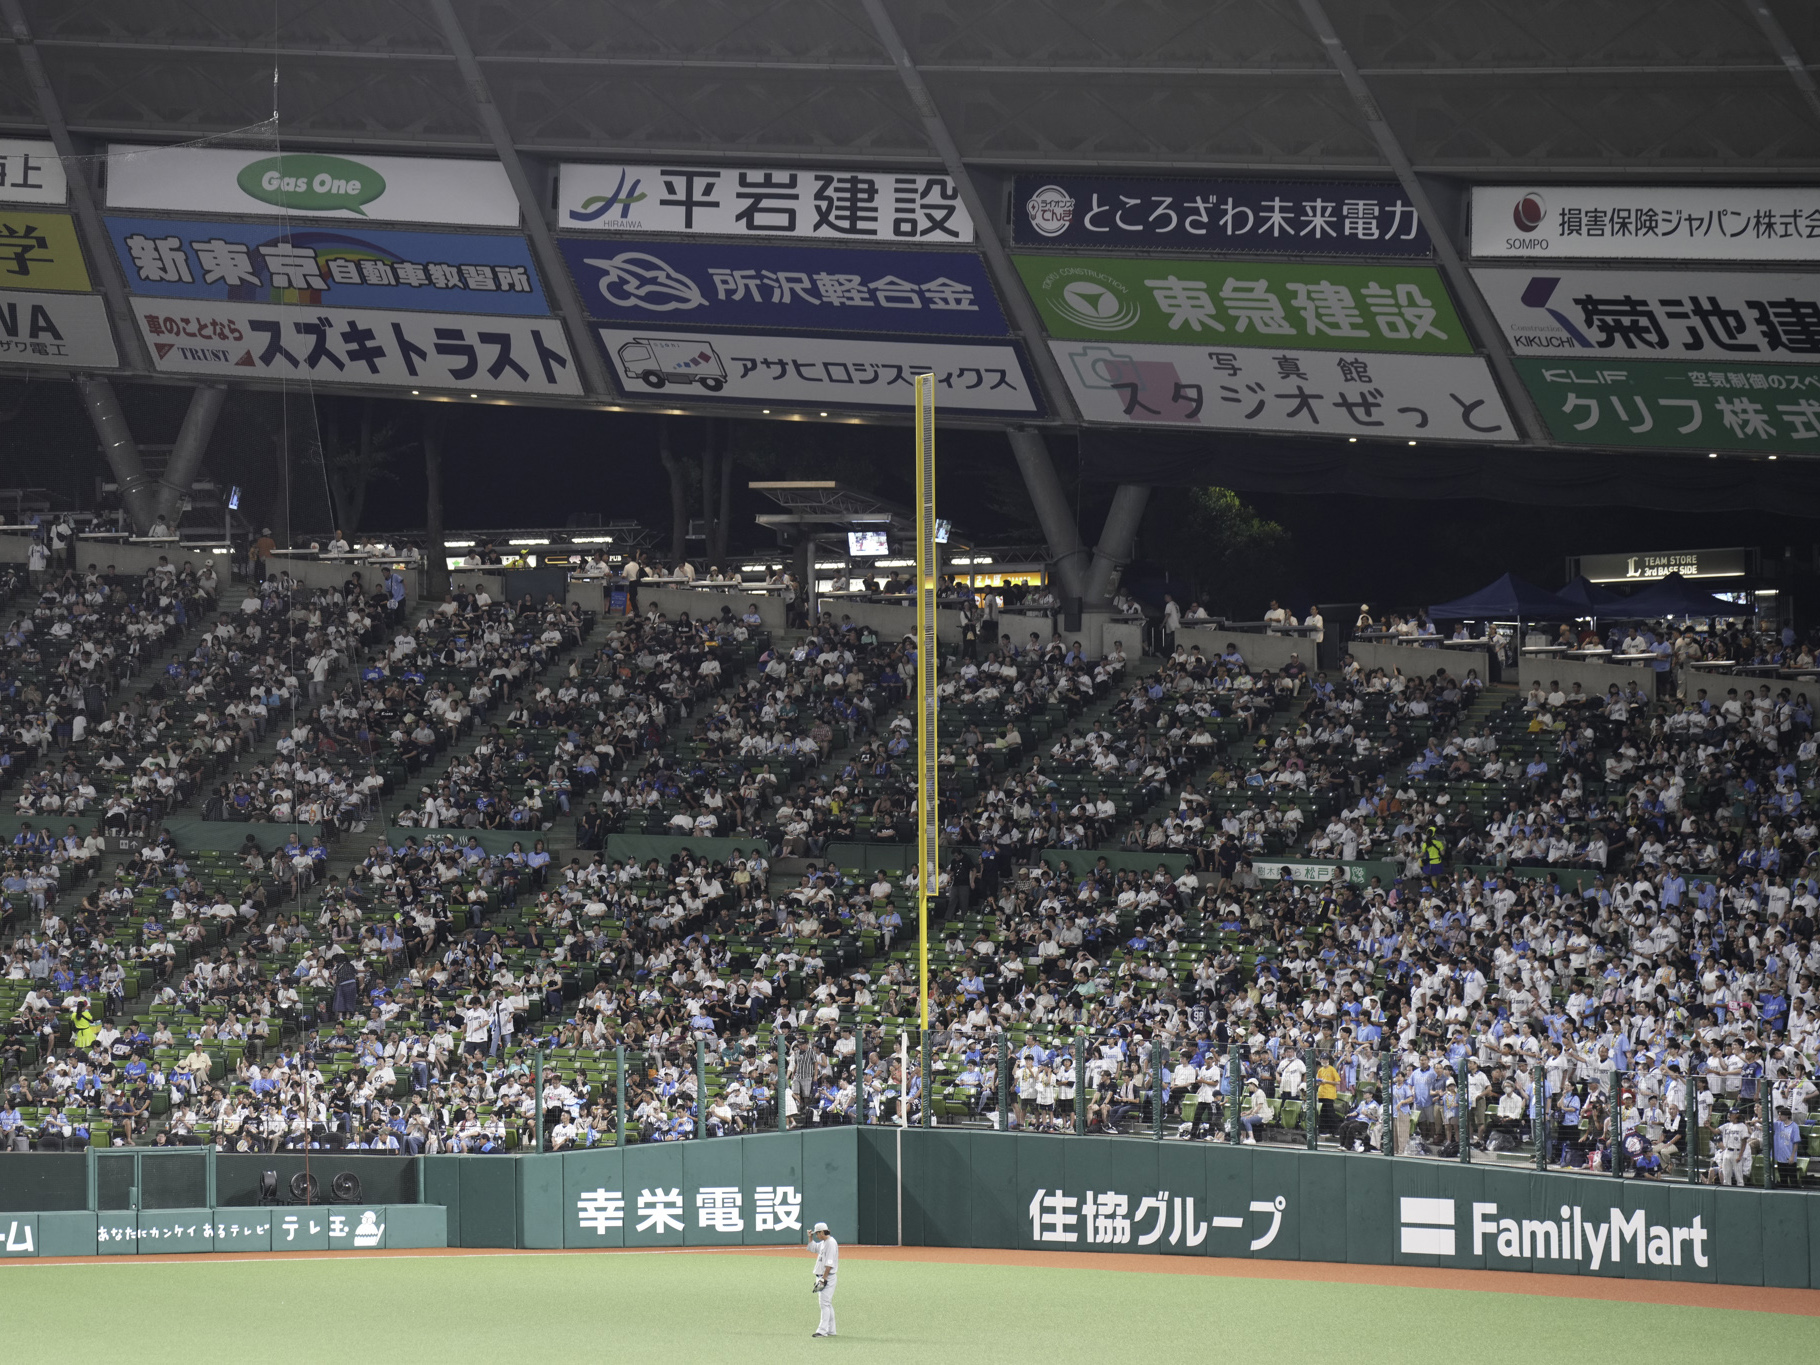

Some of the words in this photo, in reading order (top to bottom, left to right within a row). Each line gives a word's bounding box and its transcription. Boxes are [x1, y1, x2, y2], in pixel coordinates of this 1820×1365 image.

[261, 170, 308, 193] Gas
[313, 172, 362, 195] One
[659, 166, 961, 239] 平岩建設
[1040, 199, 1075, 209] ライオンズ
[1084, 192, 1419, 240] ところざわ未来電力
[603, 219, 643, 229] HIRAIWA
[1506, 237, 1550, 251] SOMPO
[125, 234, 331, 291] 新東京
[327, 258, 533, 294] 自動車教習所
[707, 266, 980, 312] 所沢軽合金
[1042, 271, 1060, 291] TOKYU
[1059, 267, 1129, 294] CONSTRUCTION
[1143, 275, 1448, 341] 東急建設
[143, 314, 244, 342] 車のことなら
[1510, 323, 1563, 334] Construction
[1513, 335, 1575, 349] KIKUCHI
[177, 346, 230, 363] TRUST
[247, 316, 568, 385] スズキトラスト
[730, 356, 1018, 392] アサヒロジスティクス
[1208, 351, 1374, 385] 写真館
[1110, 380, 1503, 434] スタジオぜっと
[1644, 556, 1668, 567] TEAM
[1669, 554, 1698, 565] STORE
[1644, 567, 1657, 576] 3rd
[1658, 566, 1678, 575] BASE
[1679, 564, 1698, 575] SIDE
[577, 1186, 802, 1235] 幸栄電設
[1029, 1189, 1287, 1251] 住協グループ
[0, 1221, 34, 1252] ム
[282, 1216, 349, 1241] テレ玉
[1472, 1202, 1709, 1270] FamilyMart
